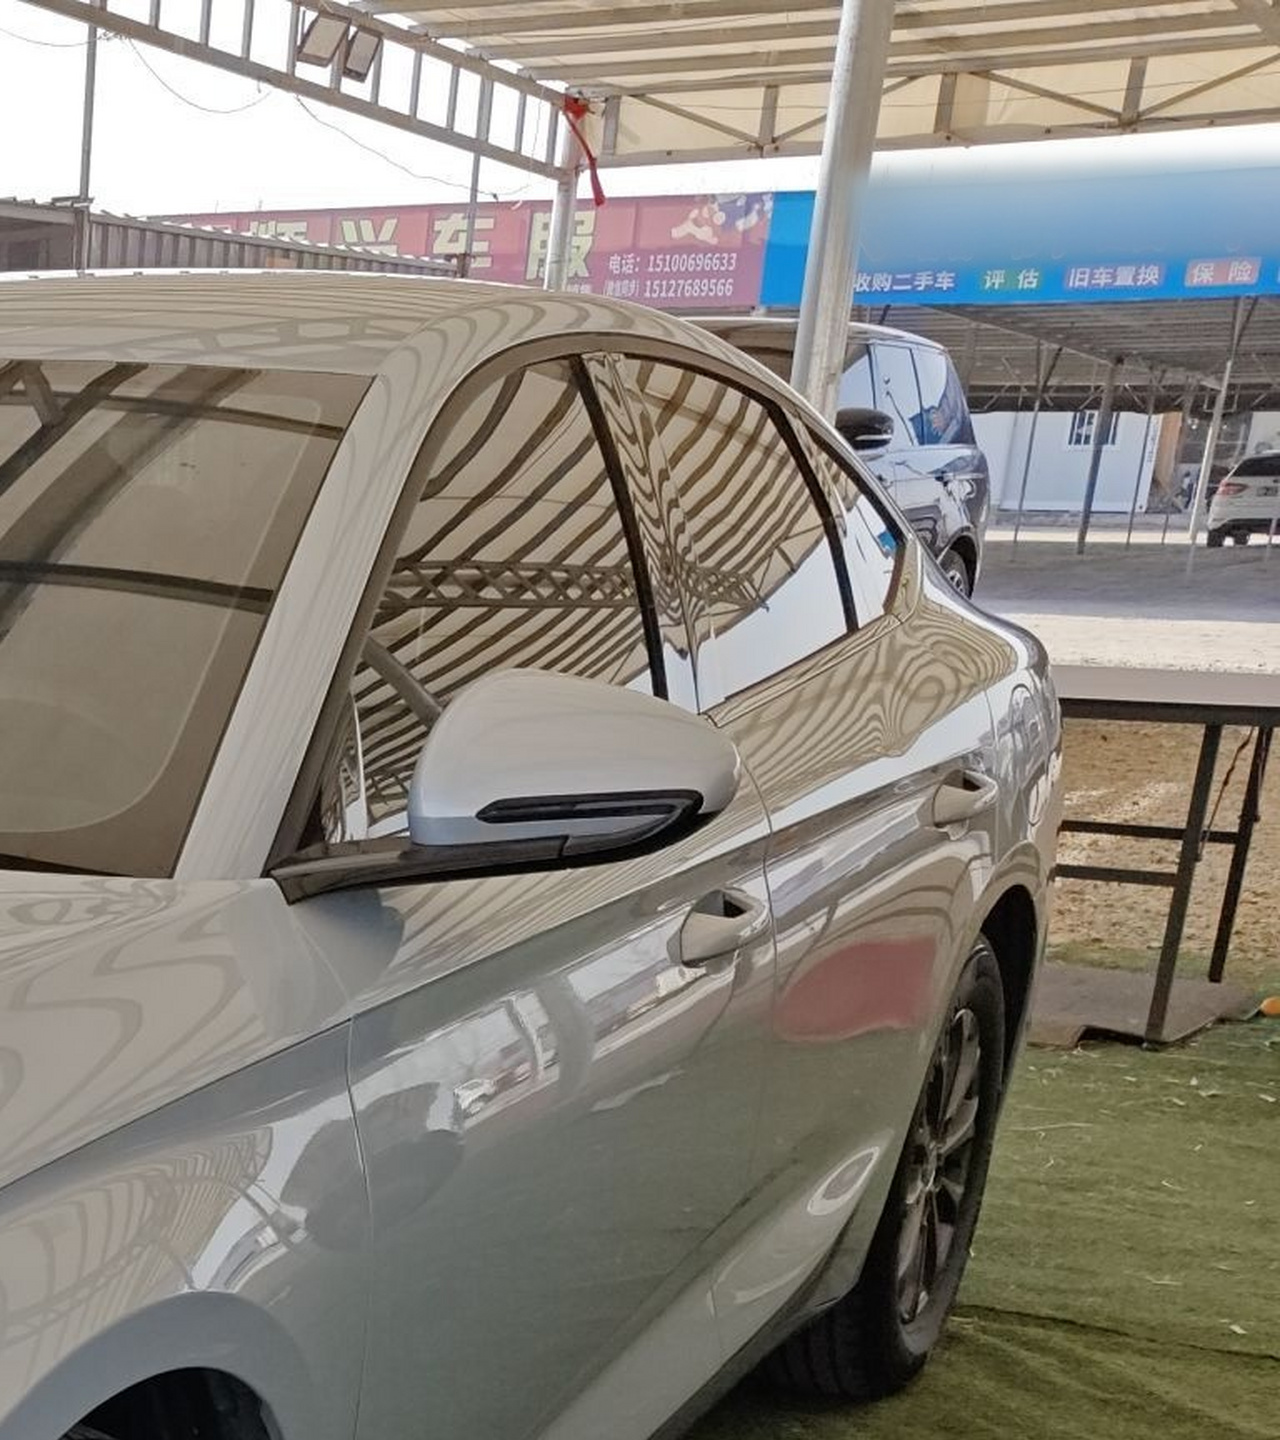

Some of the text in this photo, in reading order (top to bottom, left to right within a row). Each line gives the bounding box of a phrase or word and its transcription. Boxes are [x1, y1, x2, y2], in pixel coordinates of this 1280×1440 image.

[646, 252, 738, 273] 15100696633
[853, 260, 1253, 293] 收购二手车 评估 旧车置换 保险
[643, 278, 734, 299] 15127689566
